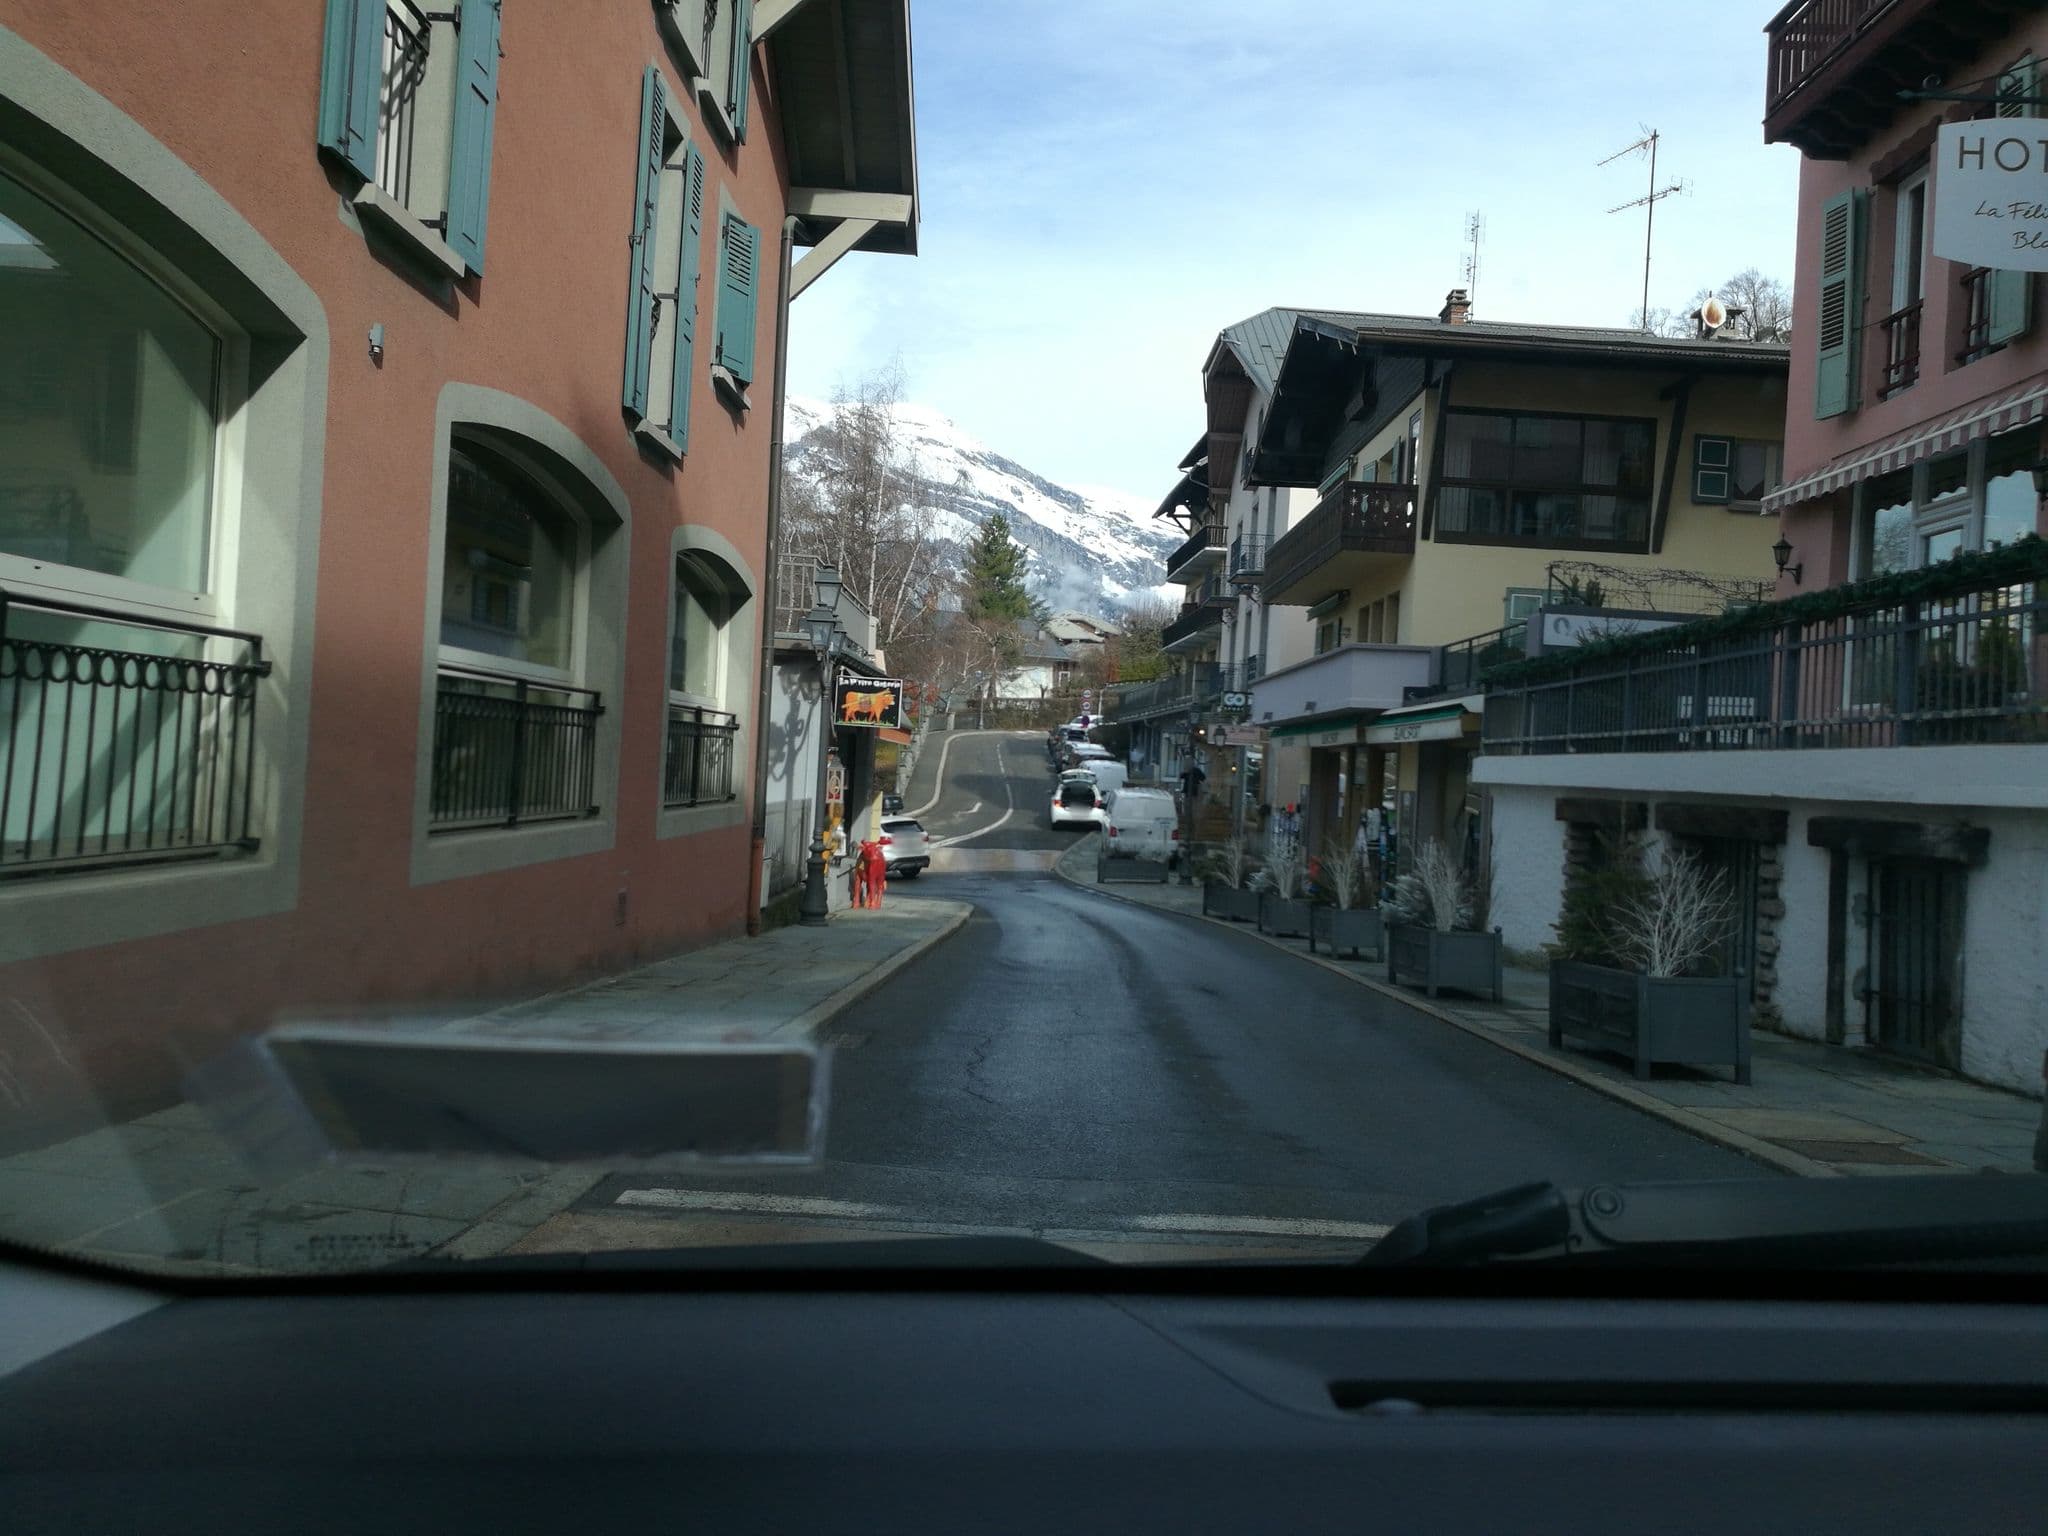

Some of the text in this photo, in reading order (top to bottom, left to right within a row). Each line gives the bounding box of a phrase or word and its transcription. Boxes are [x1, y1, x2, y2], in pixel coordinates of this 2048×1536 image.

[1959, 136, 2048, 173] HOT
[1975, 200, 2004, 218] La
[839, 677, 849, 686] La
[1224, 693, 1245, 706] GO
